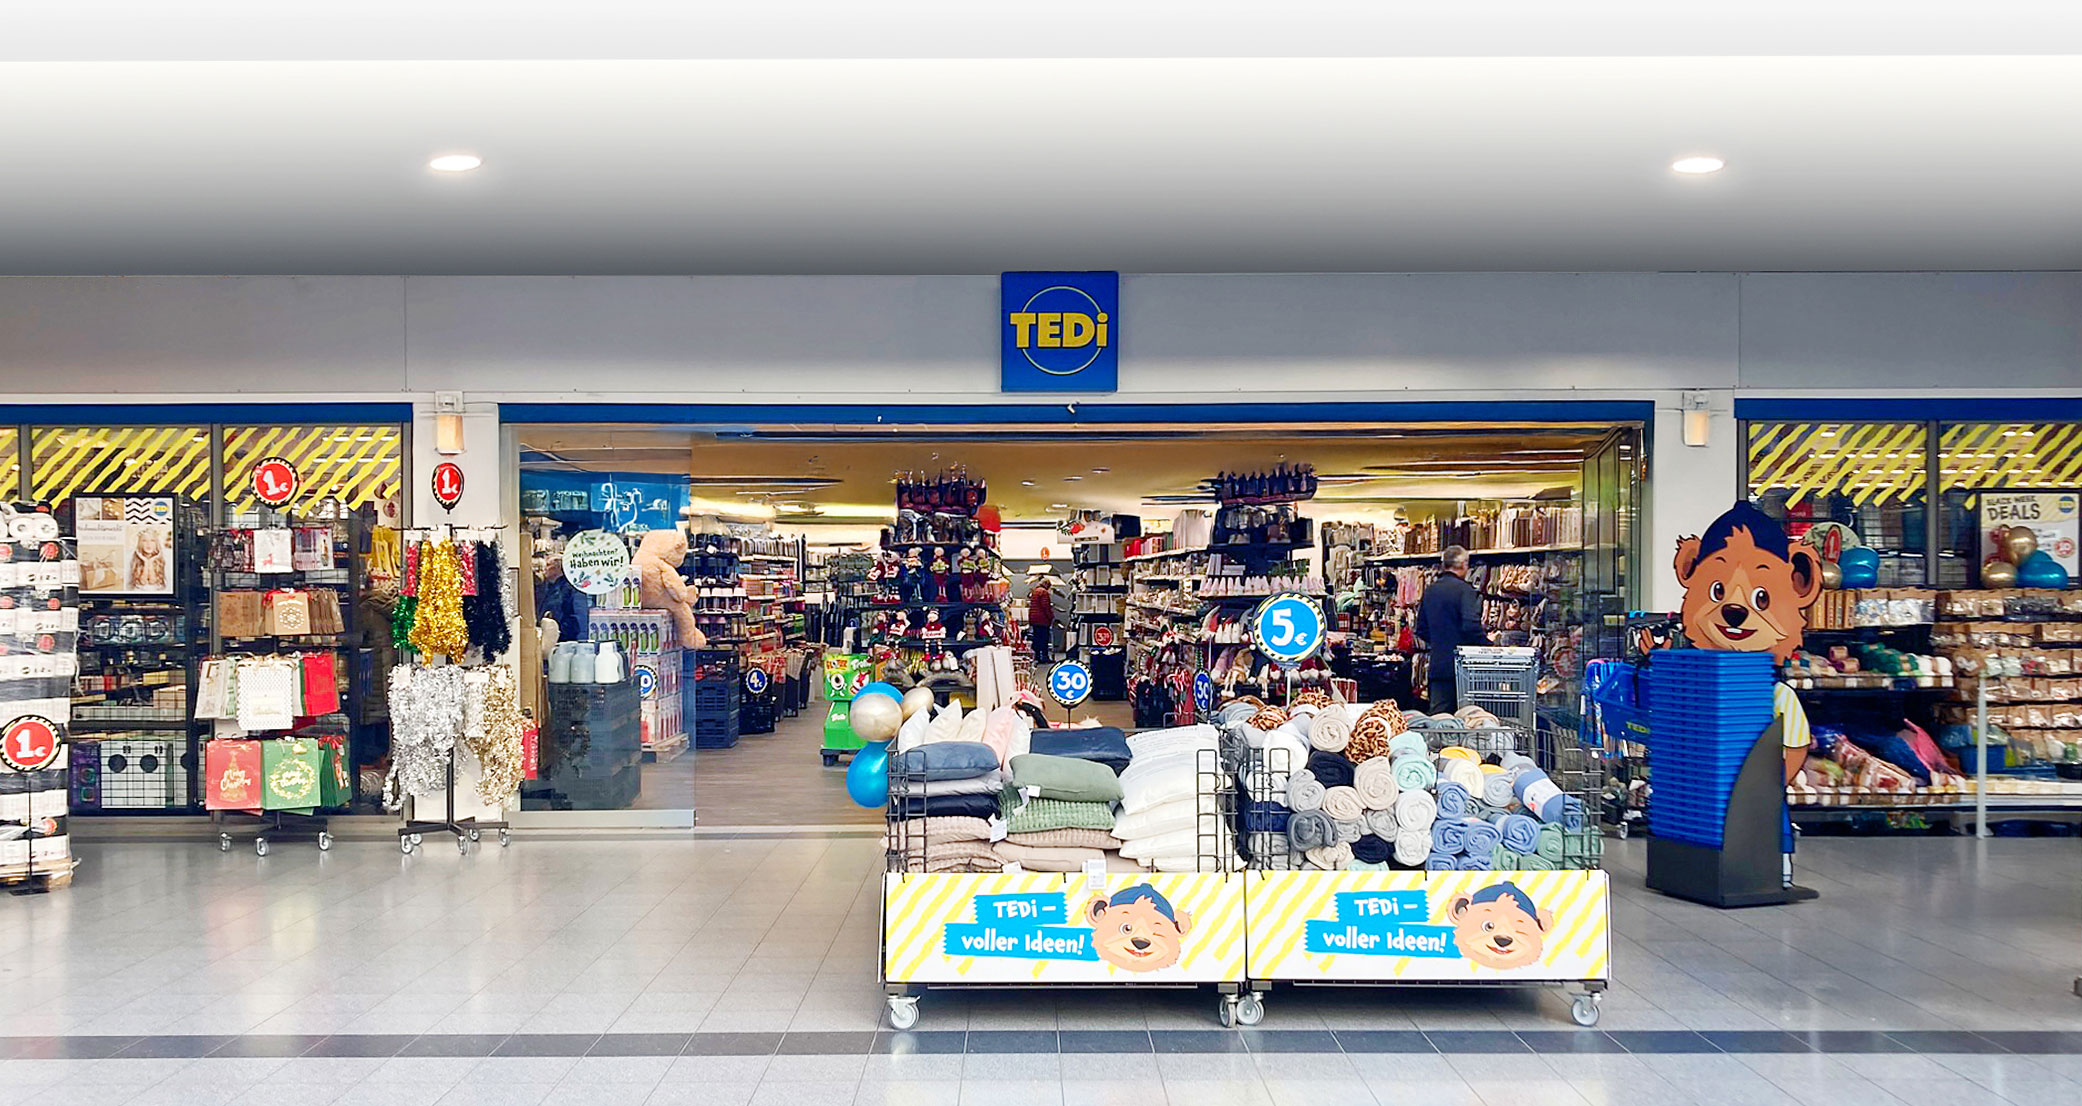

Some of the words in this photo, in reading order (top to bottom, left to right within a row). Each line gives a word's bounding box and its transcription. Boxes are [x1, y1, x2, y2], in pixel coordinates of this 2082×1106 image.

[1010, 312, 1108, 348] TEDi
[1987, 503, 2040, 520] DEALS
[570, 558, 600, 569] Haben
[601, 556, 624, 568] wir!
[571, 548, 618, 559] Weihnachten?
[1270, 607, 1308, 646] 5€
[1056, 671, 1086, 690] 30
[993, 899, 1037, 918] TEDi
[1354, 897, 1399, 916] TEDi
[961, 928, 1018, 951] voller
[1025, 930, 1084, 955] Ideen!
[1323, 926, 1380, 949] voller
[1387, 928, 1446, 953] Ideen!
